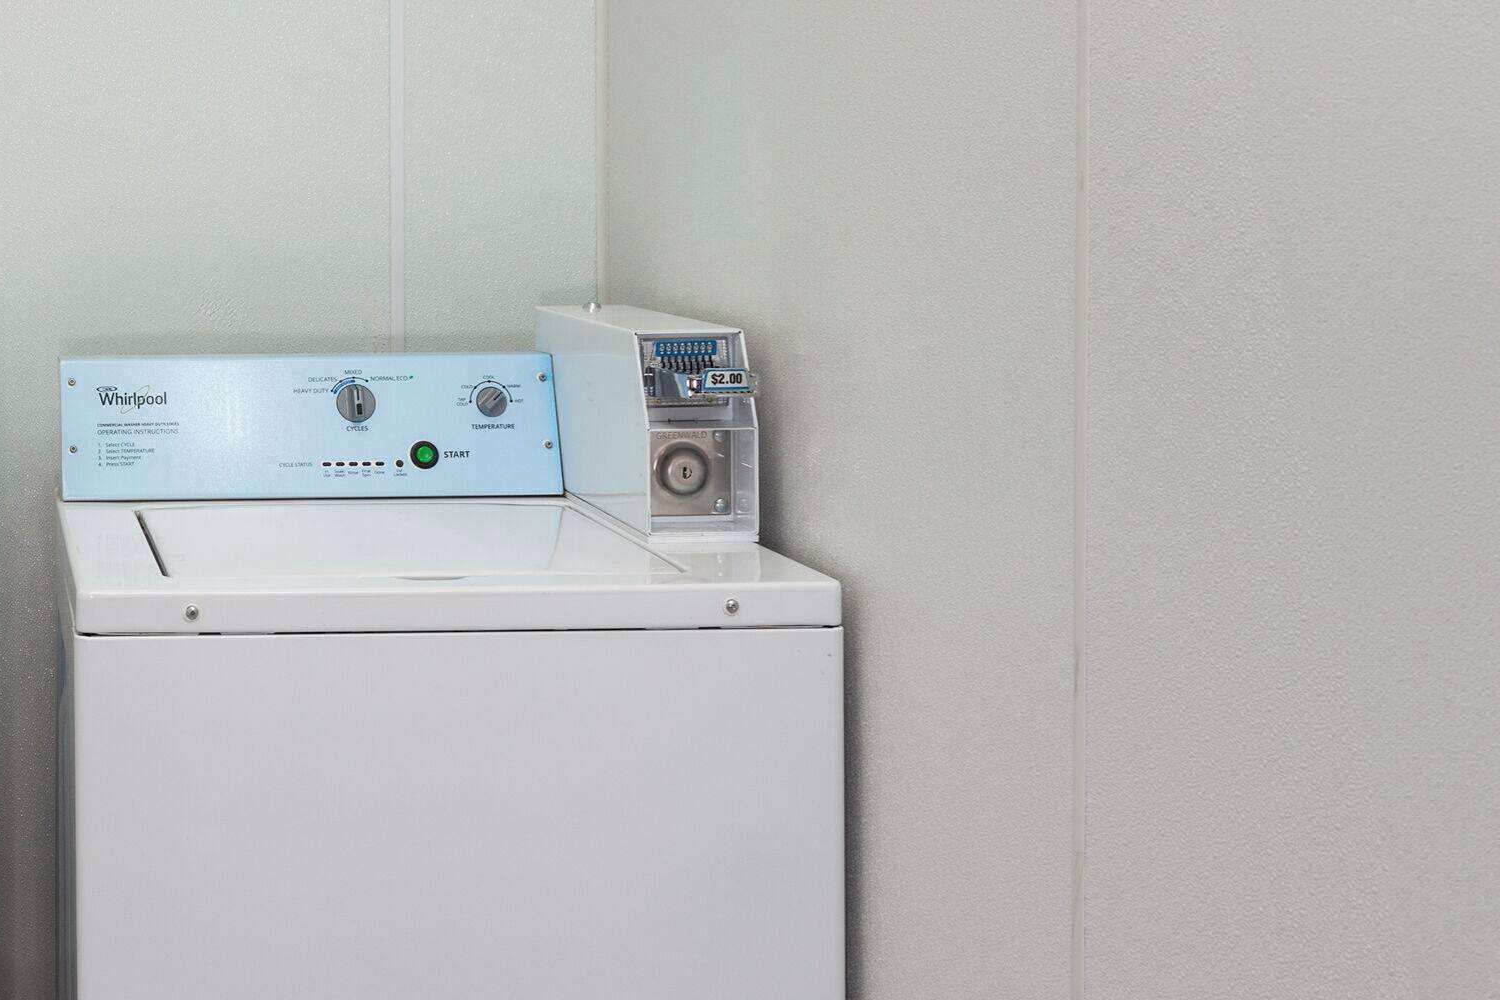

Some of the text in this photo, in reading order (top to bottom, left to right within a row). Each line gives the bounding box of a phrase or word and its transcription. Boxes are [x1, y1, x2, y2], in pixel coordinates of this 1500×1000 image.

[711, 373, 743, 386] $2.00
[98, 391, 167, 410] Whirlpool
[656, 431, 708, 440] GREENWALD
[443, 450, 471, 459] START
